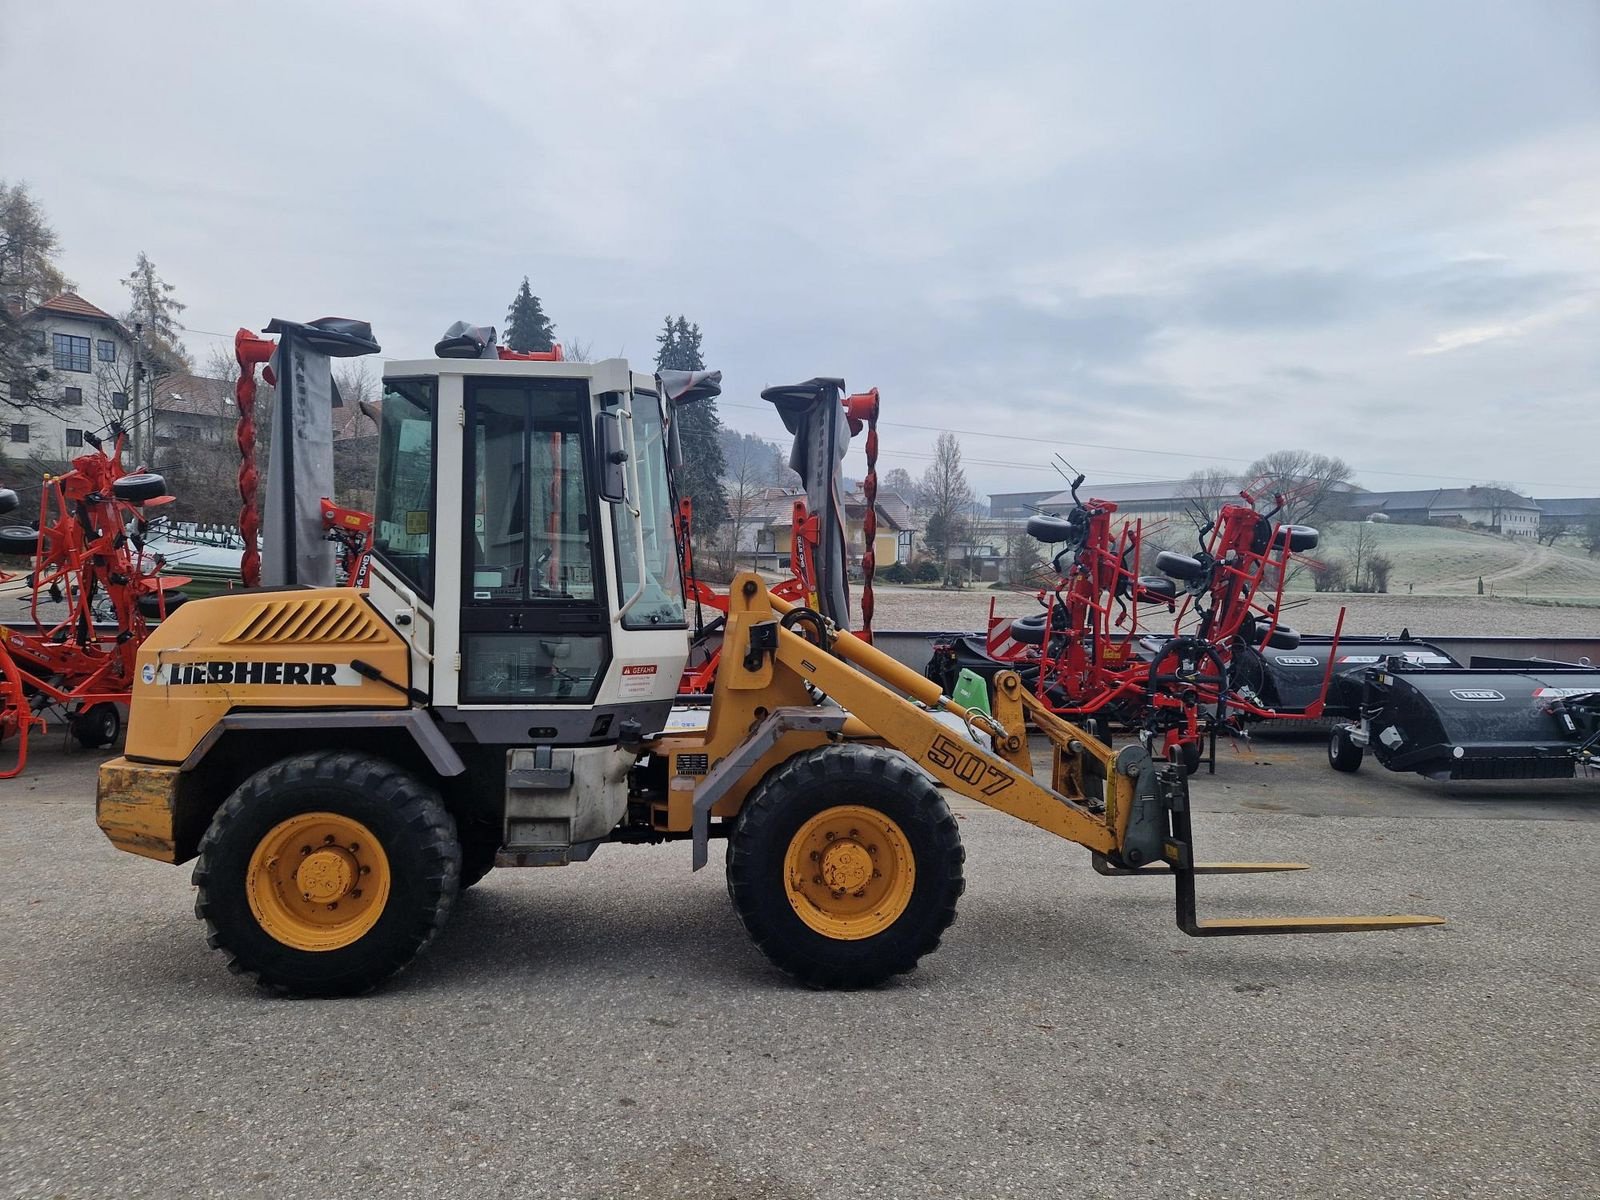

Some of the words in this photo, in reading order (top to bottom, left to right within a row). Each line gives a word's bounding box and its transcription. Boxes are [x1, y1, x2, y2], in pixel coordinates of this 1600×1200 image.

[359, 555, 370, 576] GMD
[170, 661, 337, 686] LIEBHERR
[632, 666, 655, 674] GEFAHR
[927, 734, 1015, 796] 507
